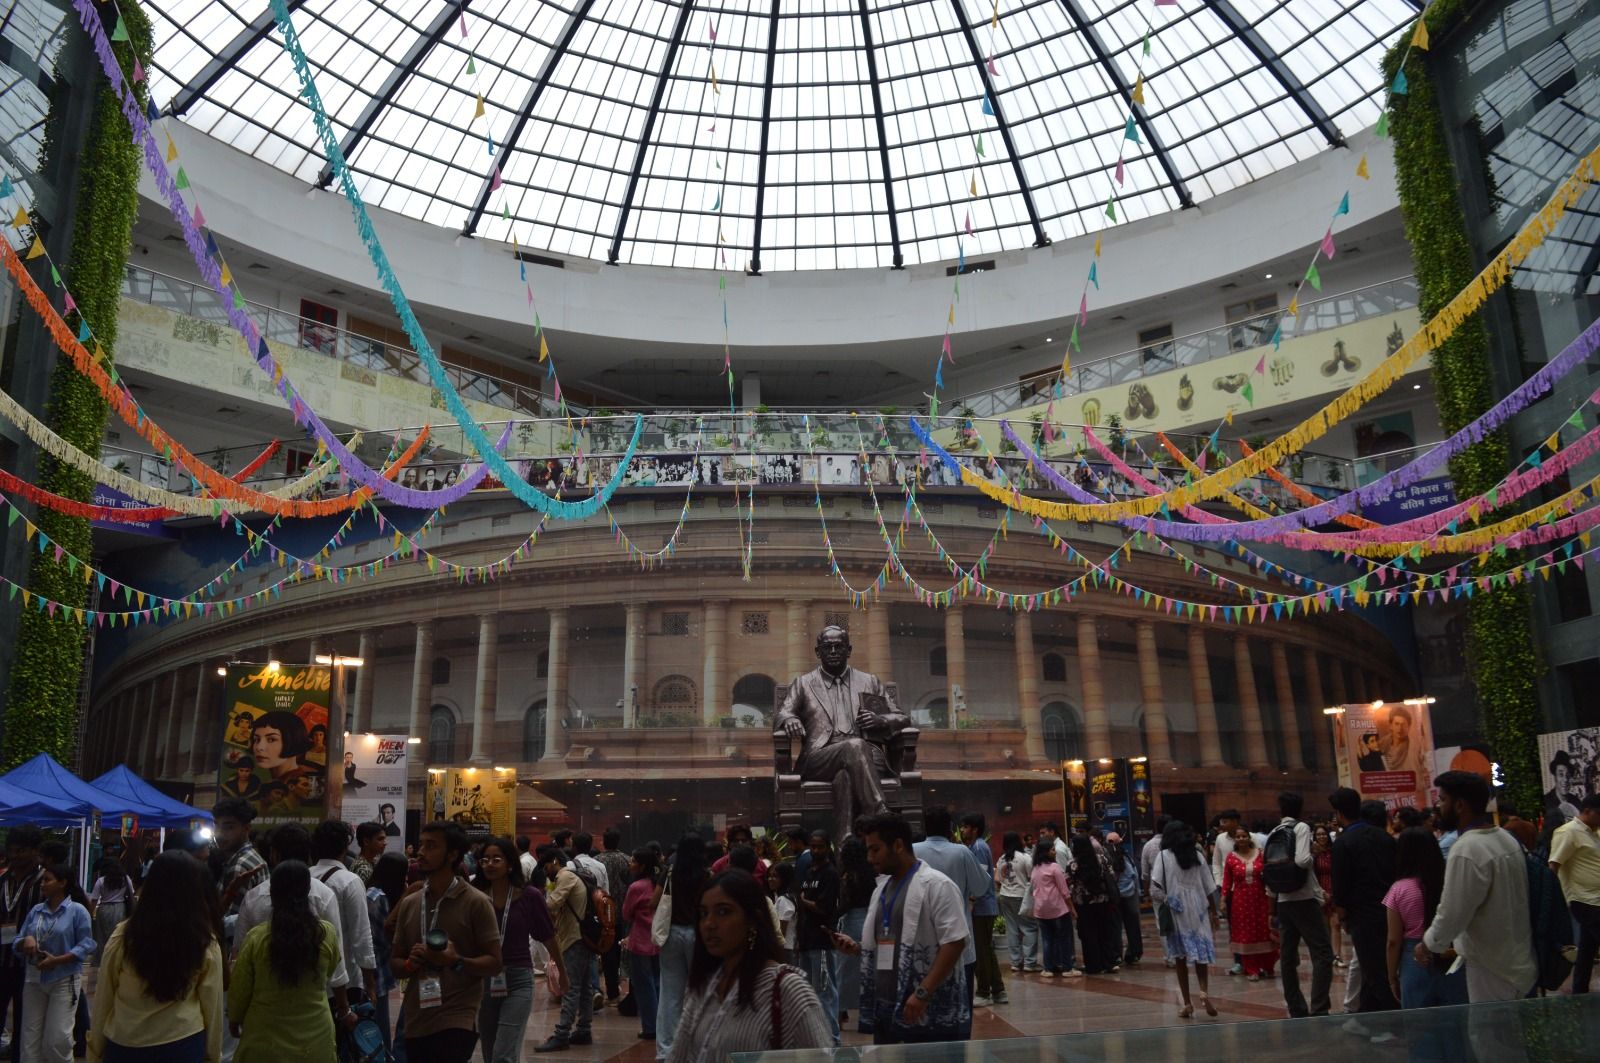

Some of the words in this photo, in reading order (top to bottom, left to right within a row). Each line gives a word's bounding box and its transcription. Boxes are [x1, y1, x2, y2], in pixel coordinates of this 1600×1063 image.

[1411, 484, 1440, 497] विकास
[95, 494, 116, 507] होना
[1400, 498, 1425, 510] अंतिम
[1429, 495, 1449, 505] लक्ष्य
[1350, 719, 1377, 729] RAHUL
[378, 741, 404, 750] MEN
[376, 754, 406, 764] 007
[1092, 782, 1116, 794] CAPE
[301, 817, 320, 825] JOYS
